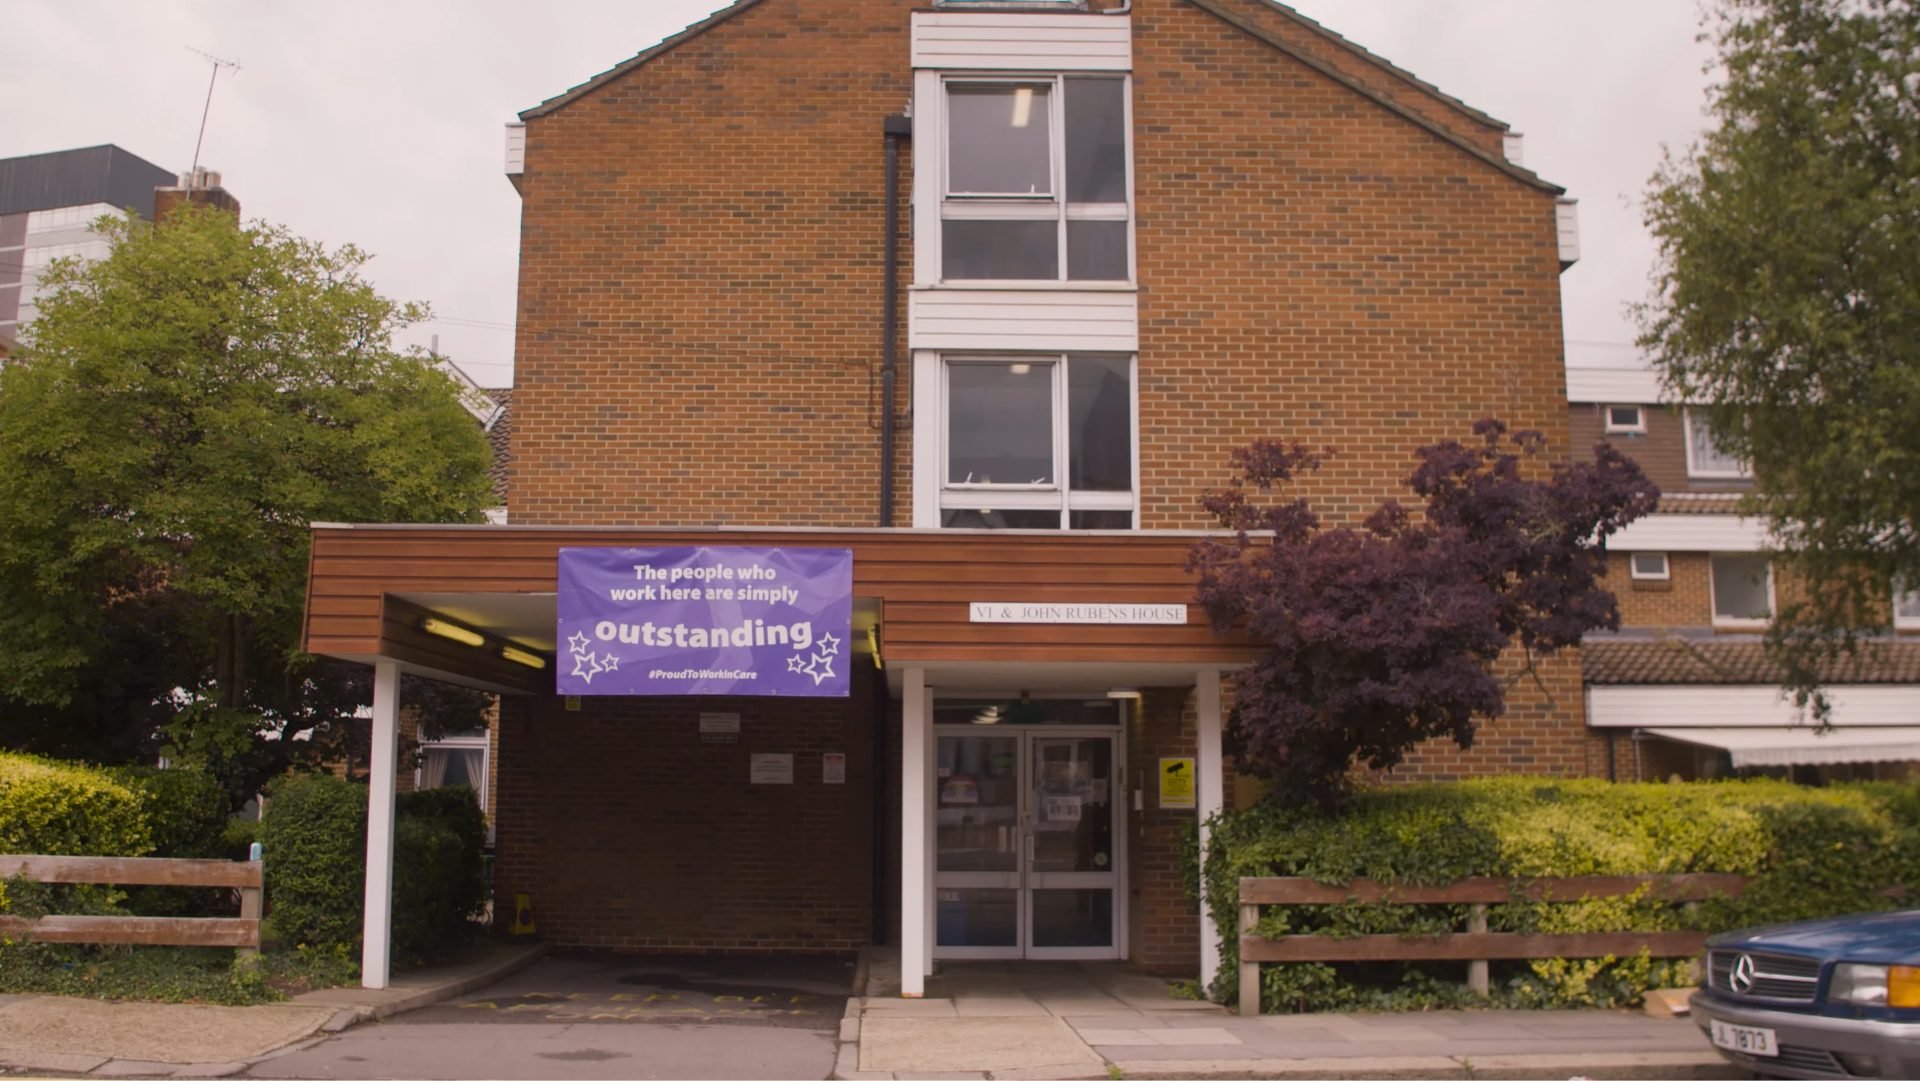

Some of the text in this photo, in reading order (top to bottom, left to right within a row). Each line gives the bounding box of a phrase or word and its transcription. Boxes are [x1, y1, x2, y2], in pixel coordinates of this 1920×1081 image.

[634, 564, 776, 582] The people who
[610, 585, 799, 605] work here are simply
[976, 606, 1183, 620] VI & JOHN RUBENS HOUSE
[595, 619, 813, 650] outstanding
